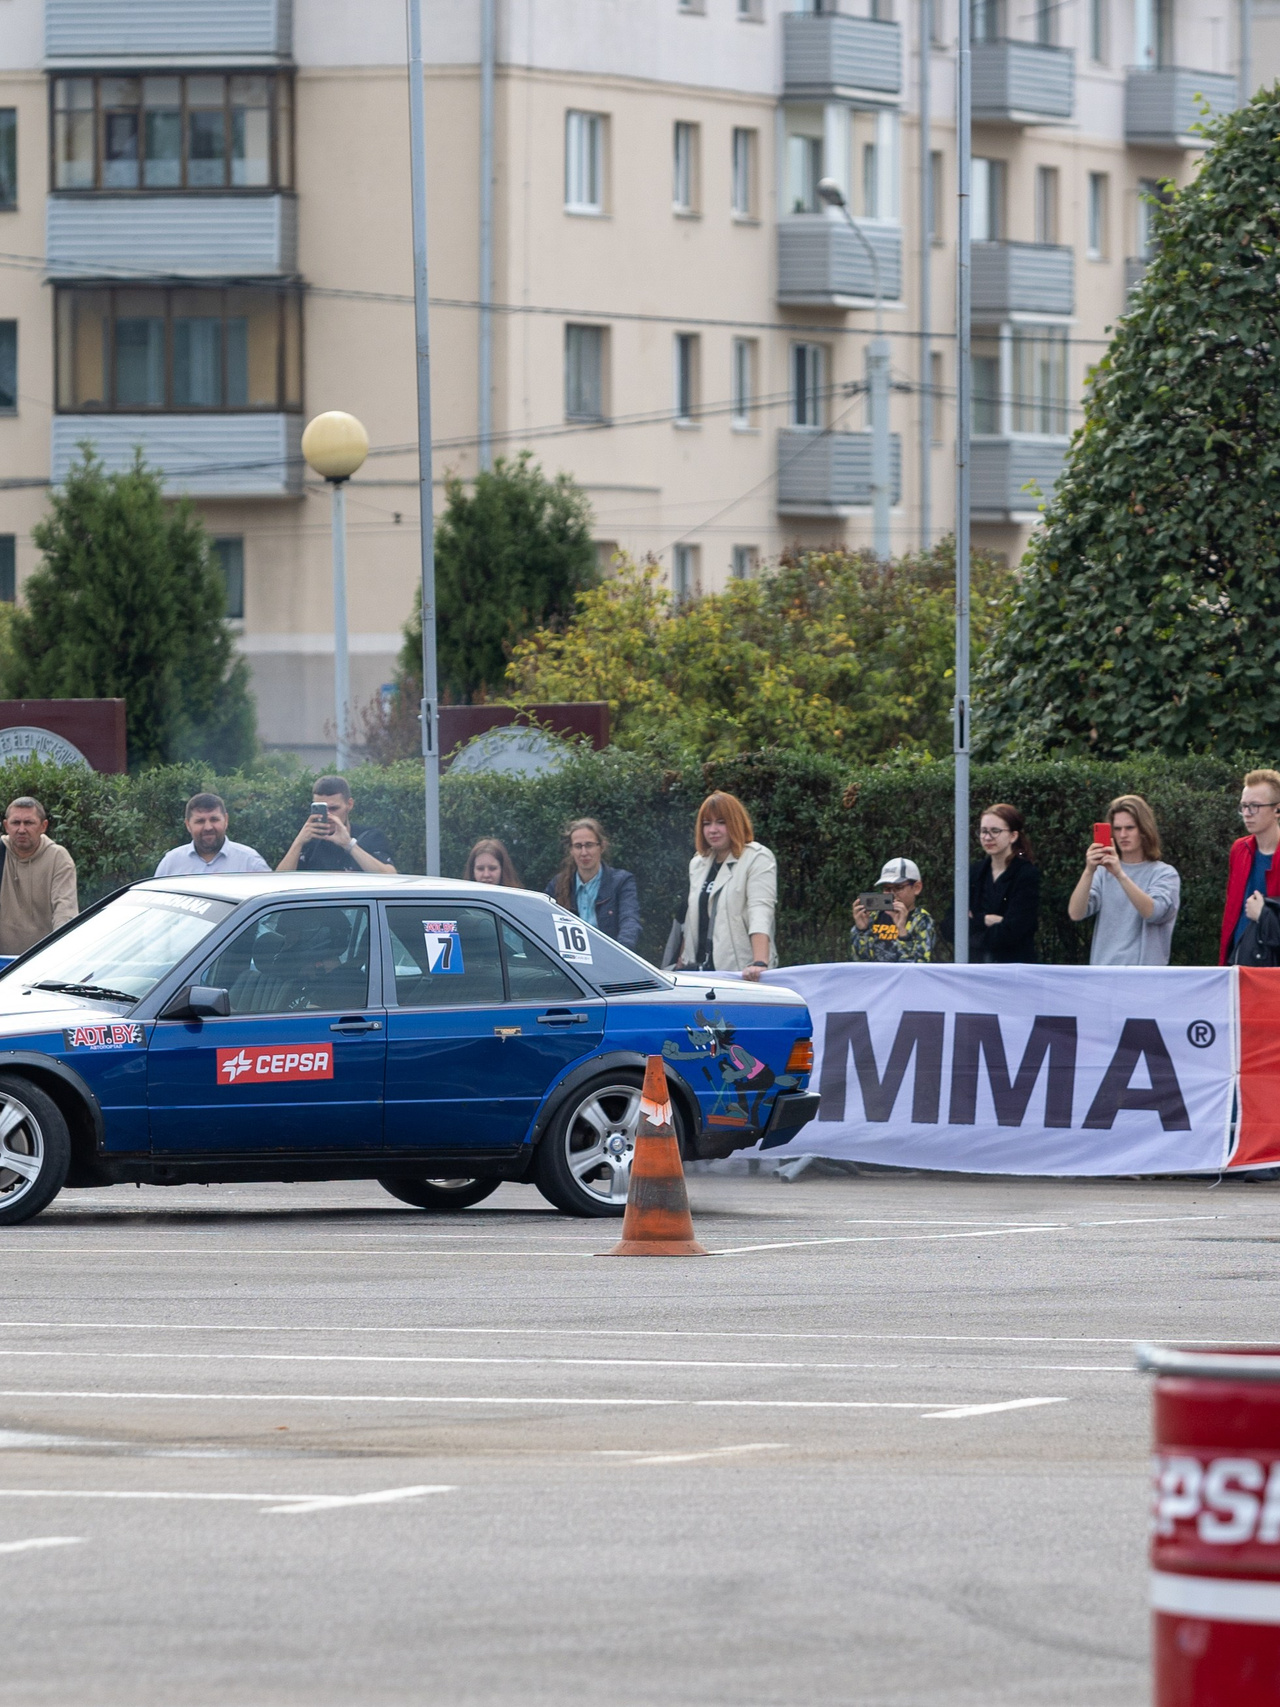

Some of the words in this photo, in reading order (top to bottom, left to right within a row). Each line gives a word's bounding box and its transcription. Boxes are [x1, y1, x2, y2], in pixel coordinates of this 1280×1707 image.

[558, 925, 586, 952] 16
[437, 937, 453, 969] 7
[74, 1024, 136, 1046] ADT.BY
[255, 1052, 329, 1074] CEPSA
